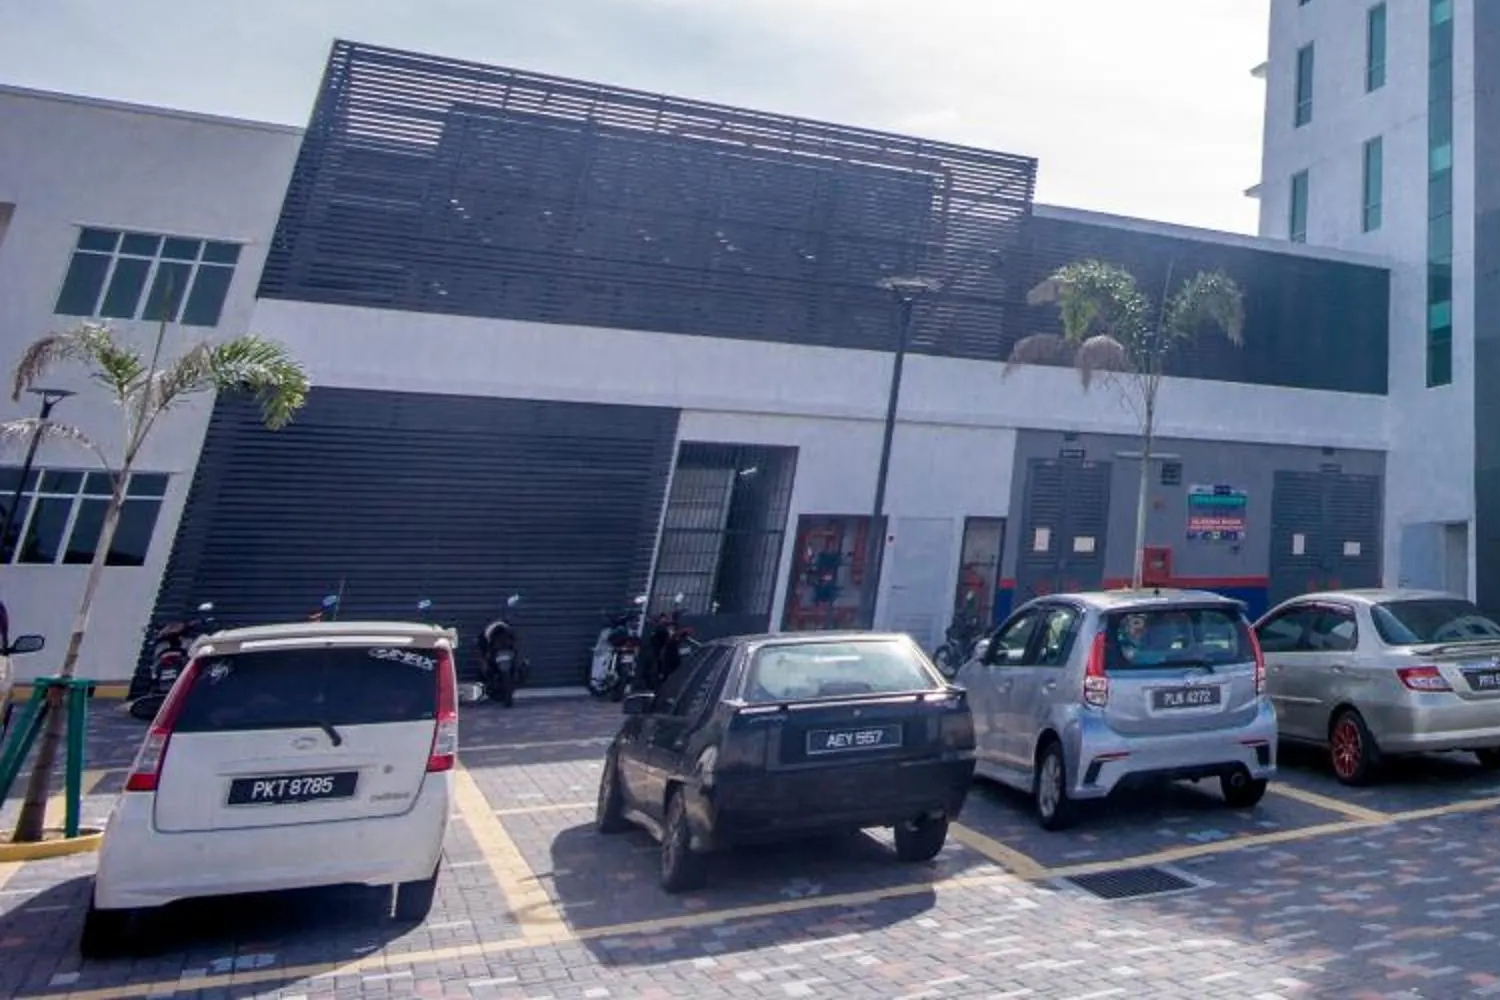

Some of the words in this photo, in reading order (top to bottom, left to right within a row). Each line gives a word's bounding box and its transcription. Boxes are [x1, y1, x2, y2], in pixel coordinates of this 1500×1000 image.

[826, 733, 853, 748] AEY
[855, 730, 884, 745] 557
[251, 779, 288, 800] PKT
[290, 776, 334, 796] 8785
